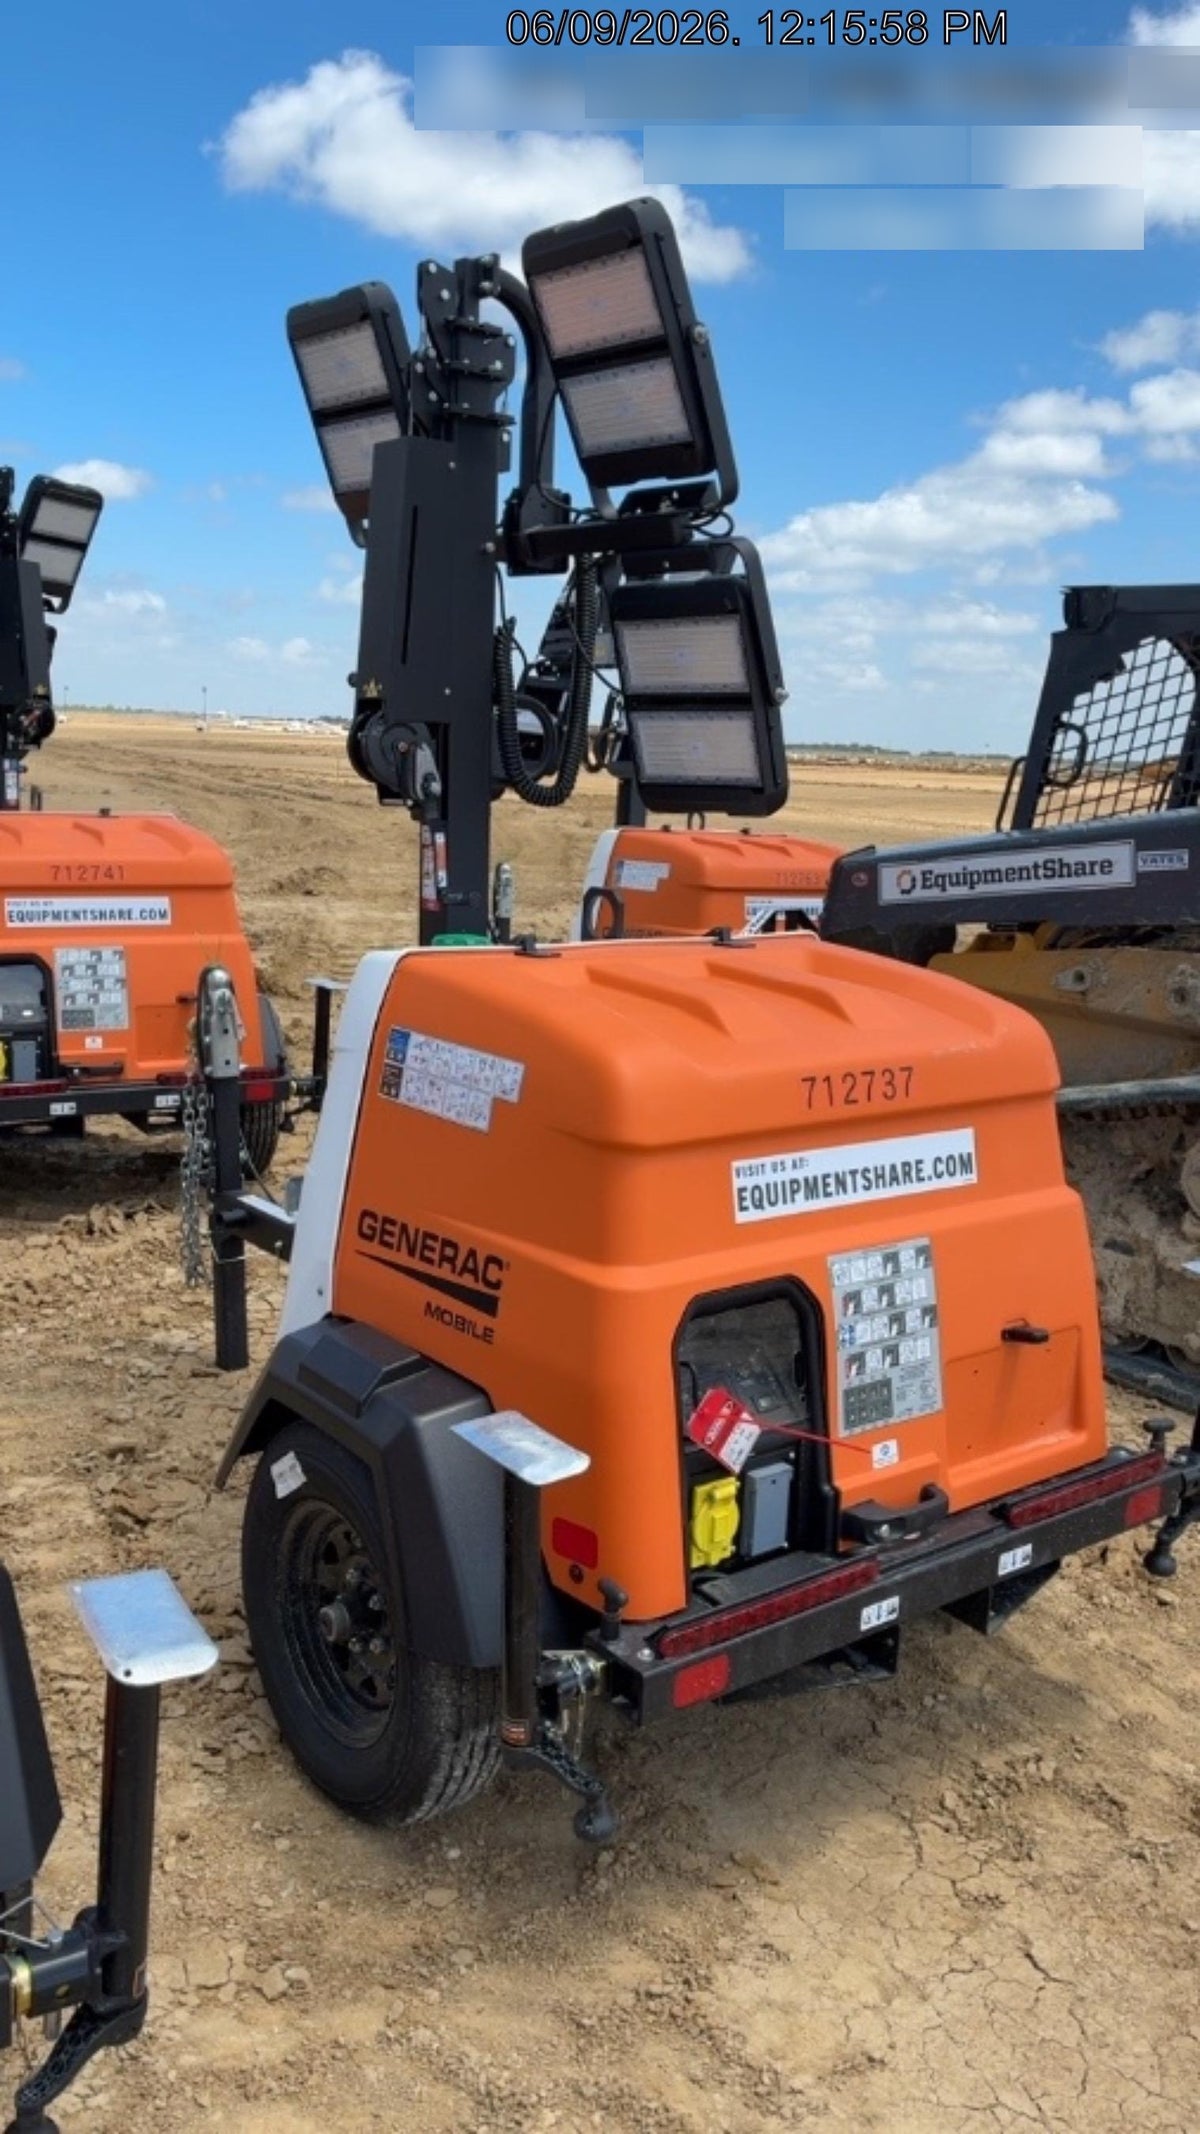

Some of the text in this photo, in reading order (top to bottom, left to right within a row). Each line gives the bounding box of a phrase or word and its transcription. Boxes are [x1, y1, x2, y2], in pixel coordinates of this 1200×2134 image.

[52, 864, 125, 880] 712741
[920, 857, 1113, 892] EquipmentShare
[8, 909, 168, 922] EQUIPMENTSHARE.COM
[801, 1066, 915, 1110] 712737
[735, 1164, 767, 1179] VISIT
[771, 1159, 786, 1172] US
[736, 1152, 974, 1213] EQUIPMENTSHARE.COM
[357, 1208, 504, 1290] GENERAC
[424, 1301, 496, 1345] MOBILE
